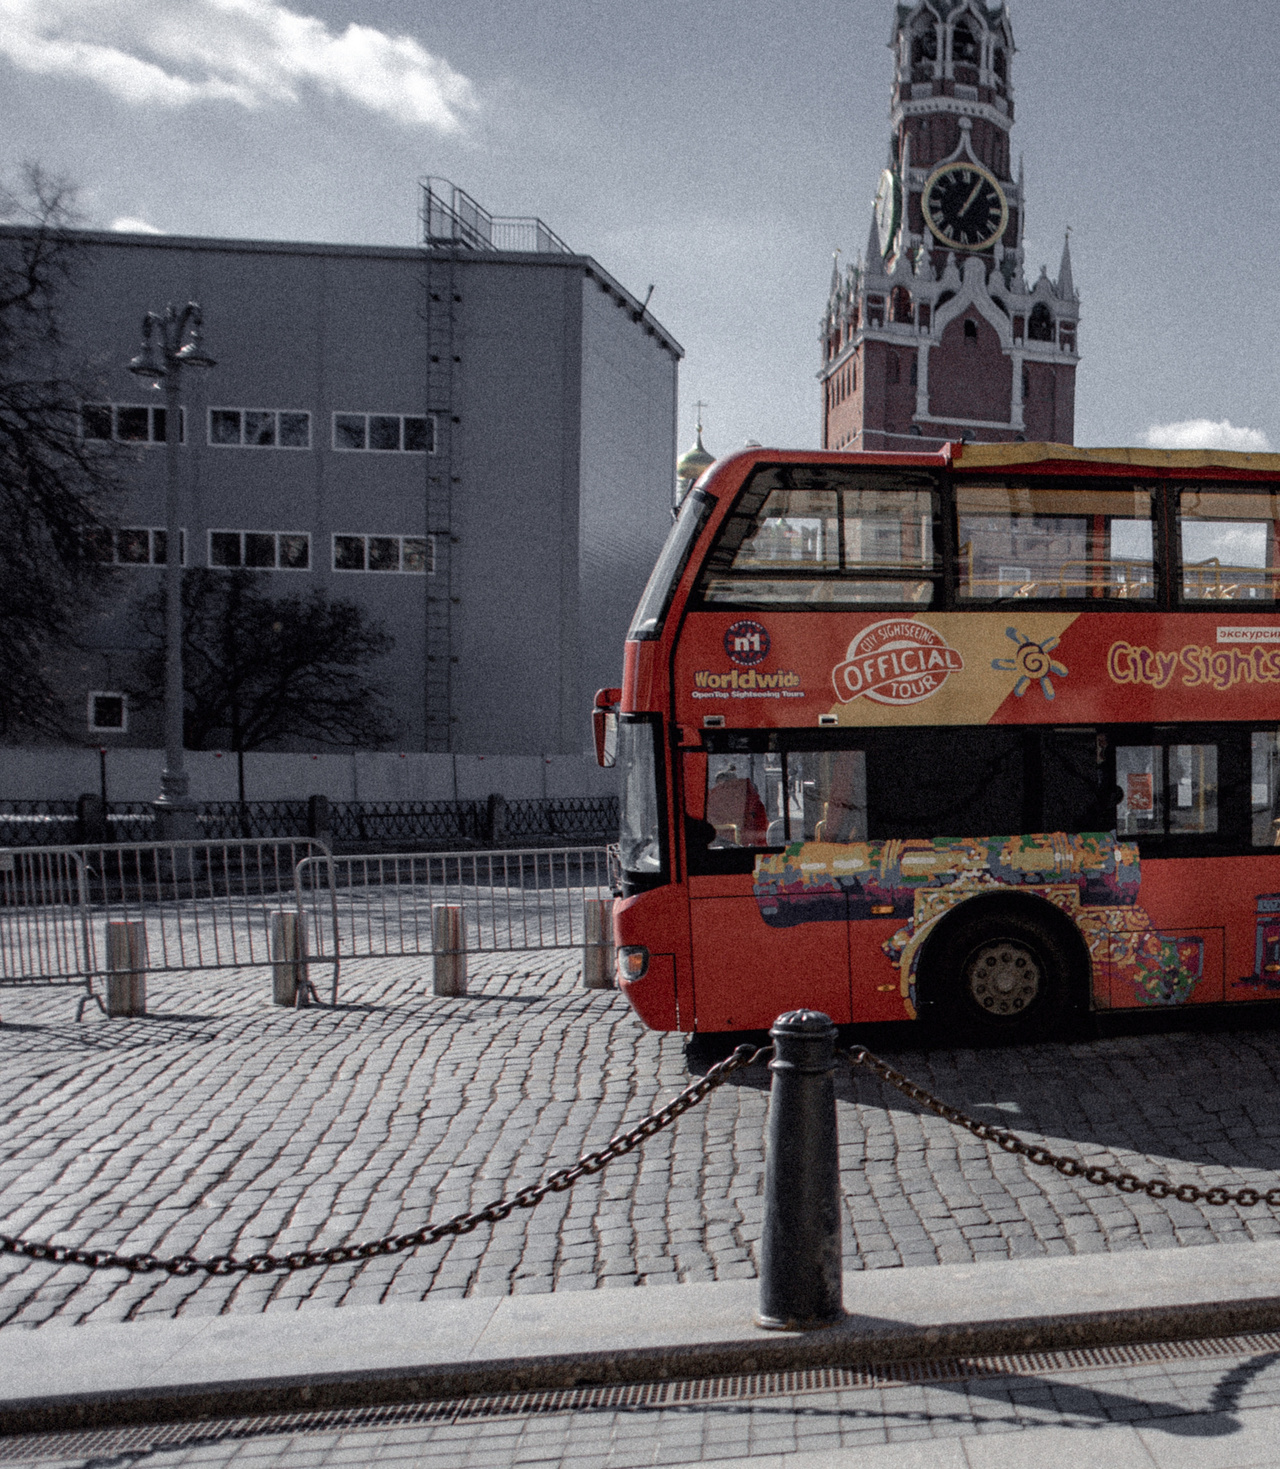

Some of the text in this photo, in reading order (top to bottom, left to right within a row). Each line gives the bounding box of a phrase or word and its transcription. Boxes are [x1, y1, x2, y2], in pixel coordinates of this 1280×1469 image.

[861, 624, 935, 653] CITY SIGHTSEEING
[694, 668, 800, 690] Worldwide
[843, 649, 959, 692] OFFICIAL
[1108, 641, 1178, 690] City
[731, 690, 780, 699] Sightseeing
[782, 690, 805, 698] Tours
[891, 674, 938, 699] TOUR
